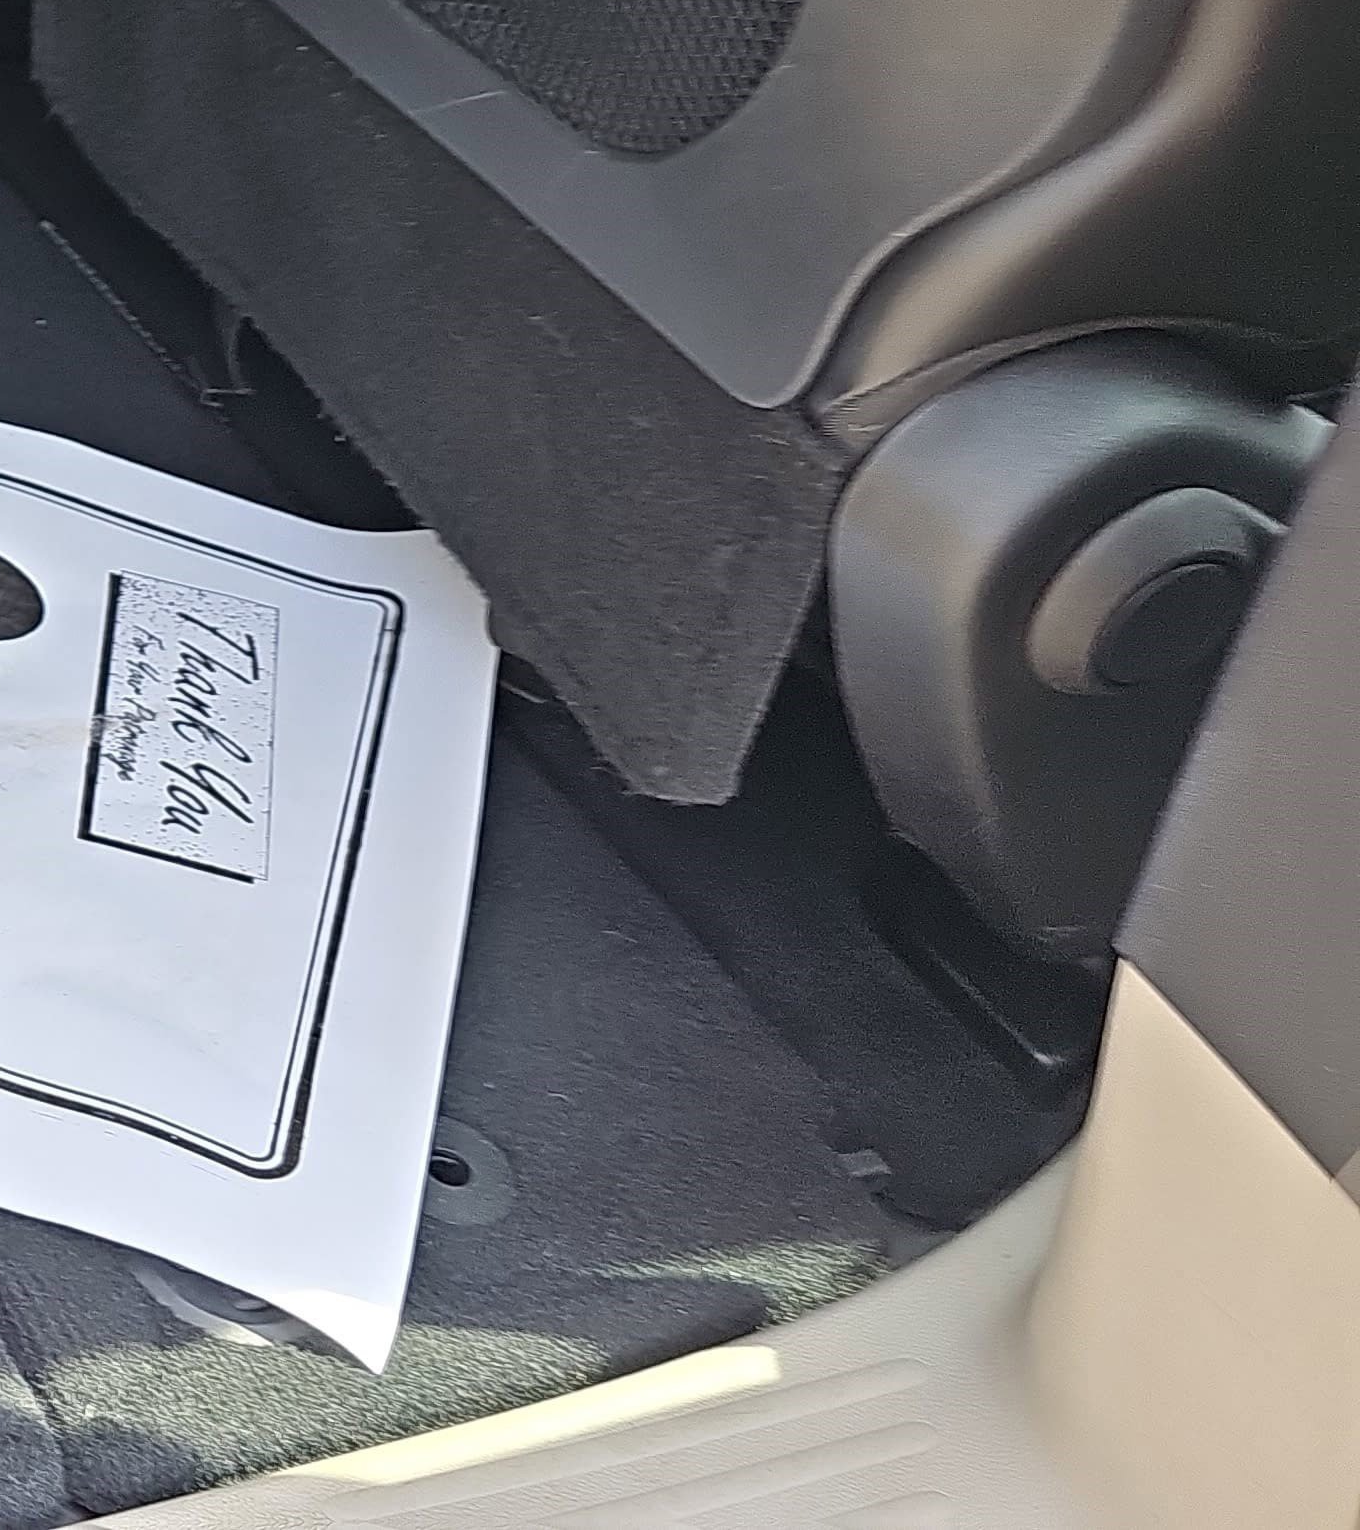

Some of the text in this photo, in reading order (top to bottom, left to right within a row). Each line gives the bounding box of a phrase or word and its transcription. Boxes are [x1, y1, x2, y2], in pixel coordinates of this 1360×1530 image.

[132, 624, 165, 657] For
[126, 659, 161, 696] Your
[160, 611, 260, 835] Thank You
